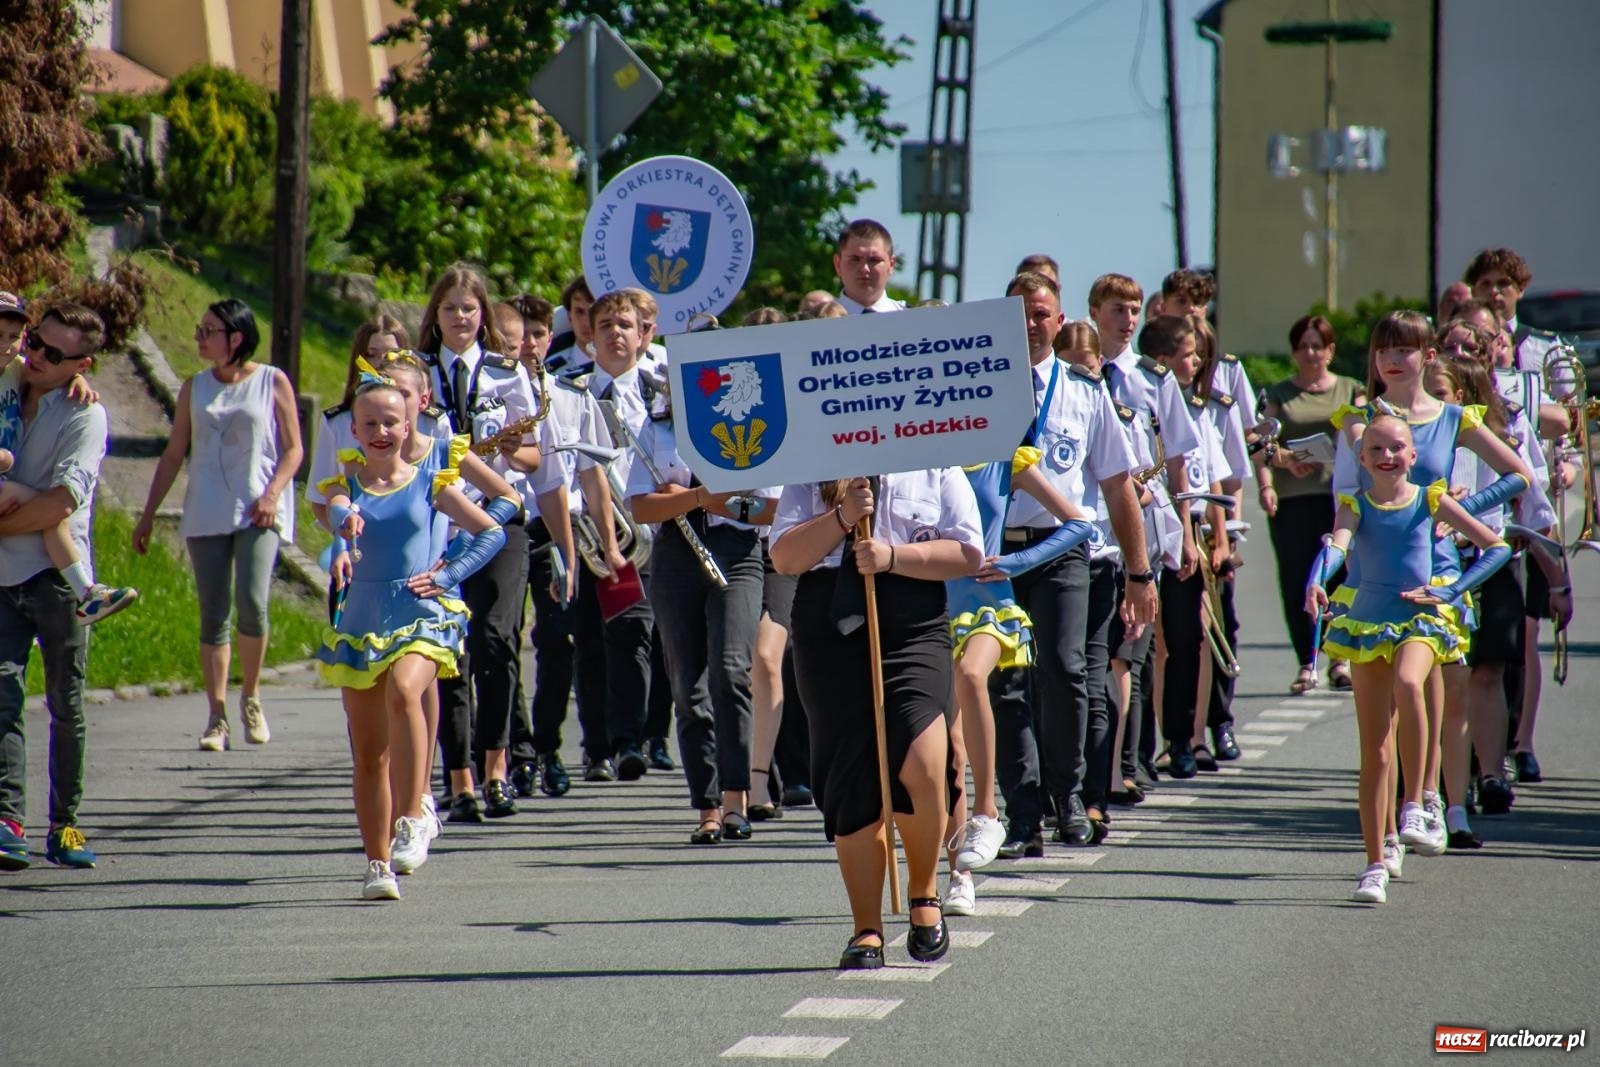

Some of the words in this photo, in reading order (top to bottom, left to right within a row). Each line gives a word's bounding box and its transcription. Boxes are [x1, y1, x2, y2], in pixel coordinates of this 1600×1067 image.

[592, 203, 618, 291] DZIEŻOWA
[616, 168, 704, 200] ORKIESTRA
[707, 183, 738, 223] DĘTA
[723, 228, 744, 285] GMINY
[811, 334, 993, 367] Młodzieżowa
[798, 366, 933, 393] Orkiestra
[943, 356, 1011, 379] Dęta
[821, 394, 905, 416] Gminy
[915, 384, 993, 407] Żytno
[832, 426, 887, 445] woj.
[894, 415, 989, 439] łódzkie
